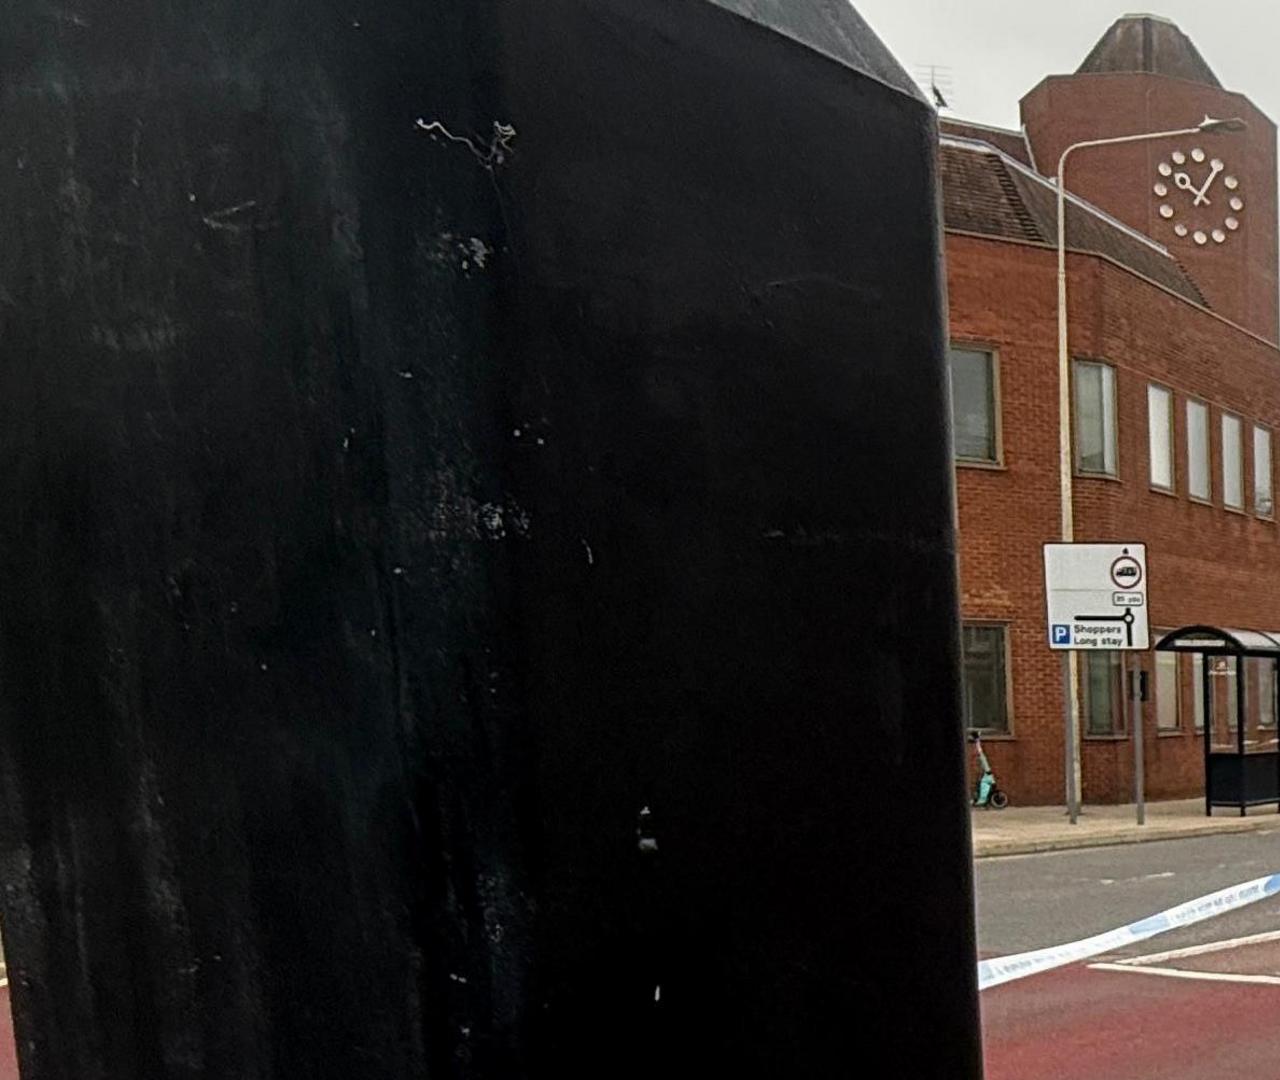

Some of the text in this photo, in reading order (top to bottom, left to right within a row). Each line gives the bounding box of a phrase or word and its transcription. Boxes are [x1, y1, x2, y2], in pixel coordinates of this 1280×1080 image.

[1073, 624, 1122, 634] Shoppers
[1073, 637, 1124, 648] Long stay
